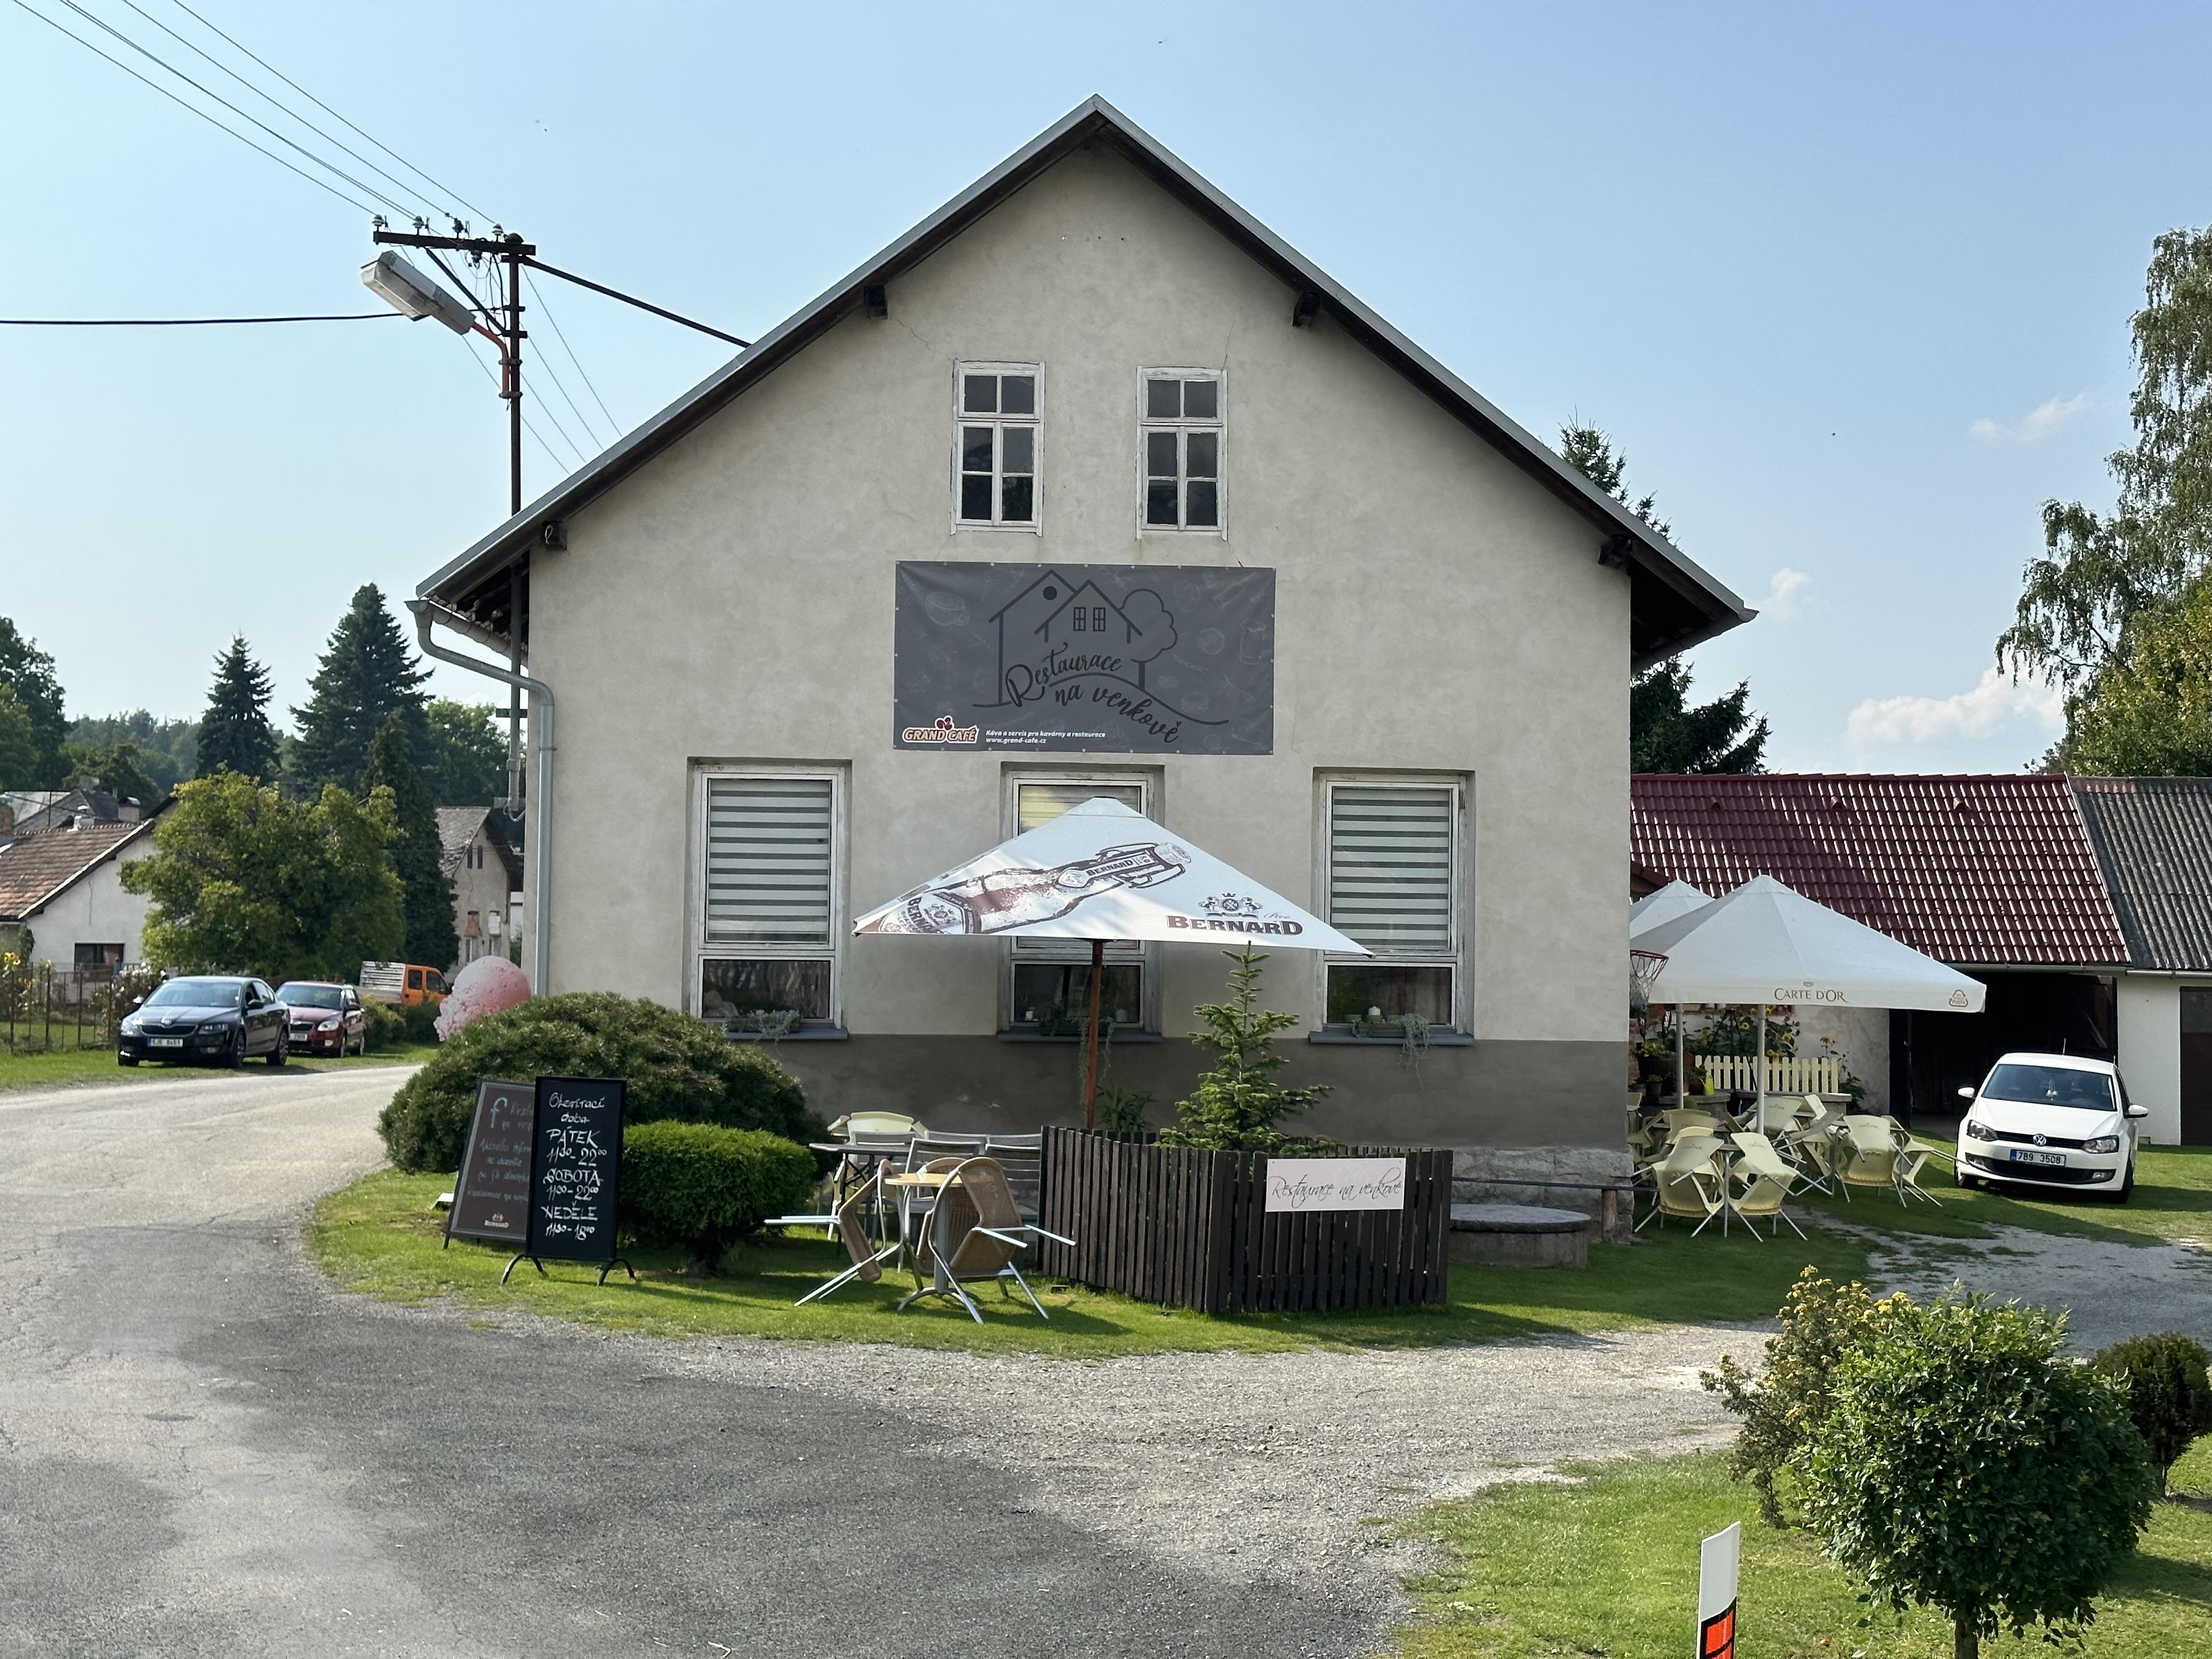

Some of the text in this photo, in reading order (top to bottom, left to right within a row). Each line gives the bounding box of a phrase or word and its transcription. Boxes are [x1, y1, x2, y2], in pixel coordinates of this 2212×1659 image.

[1005, 642, 1122, 708] Restaurace
[1055, 684, 1181, 743] na venkově
[904, 727, 977, 742] GRAND CAFÉ
[1040, 730, 1066, 738] kavárny
[1086, 856, 1134, 877] BERNARD
[1165, 915, 1303, 936] BERNARD
[1774, 988, 1849, 1003] CARTE D'OR
[549, 1092, 606, 1109] Otevírací
[561, 1112, 591, 1124] doba
[546, 1126, 601, 1149] PÁTEK
[2040, 1154, 2062, 1165] 3508
[542, 1167, 604, 1187] SOBOTA
[1268, 1173, 1334, 1209] Restaurace
[1339, 1185, 1357, 1201] na
[540, 1200, 598, 1221] NEDĚLE
